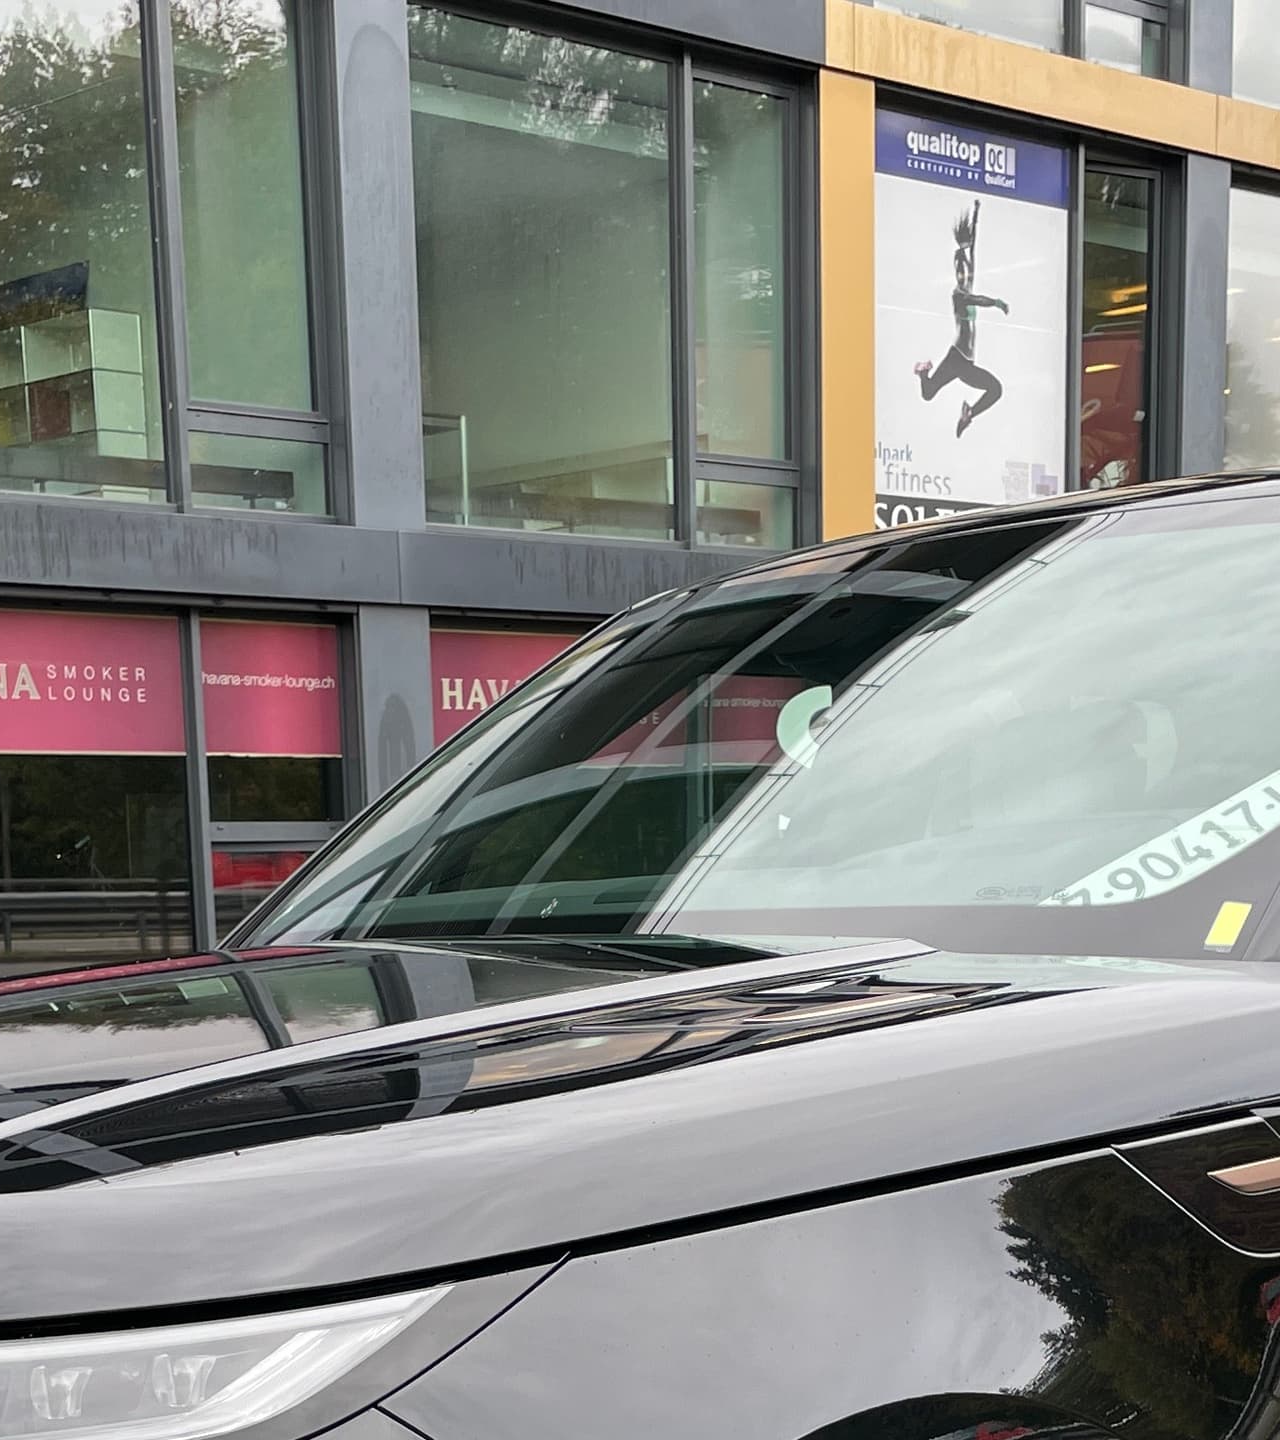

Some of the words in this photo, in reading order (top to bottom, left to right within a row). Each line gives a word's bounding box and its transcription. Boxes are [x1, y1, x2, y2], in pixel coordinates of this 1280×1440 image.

[906, 130, 981, 166] qualitop
[885, 463, 953, 496] fitness
[46, 664, 147, 683] SMOKER
[201, 671, 336, 692] havana-smoker-lounge.ch
[47, 685, 148, 703] LOUNGE
[440, 677, 523, 711] HAV
